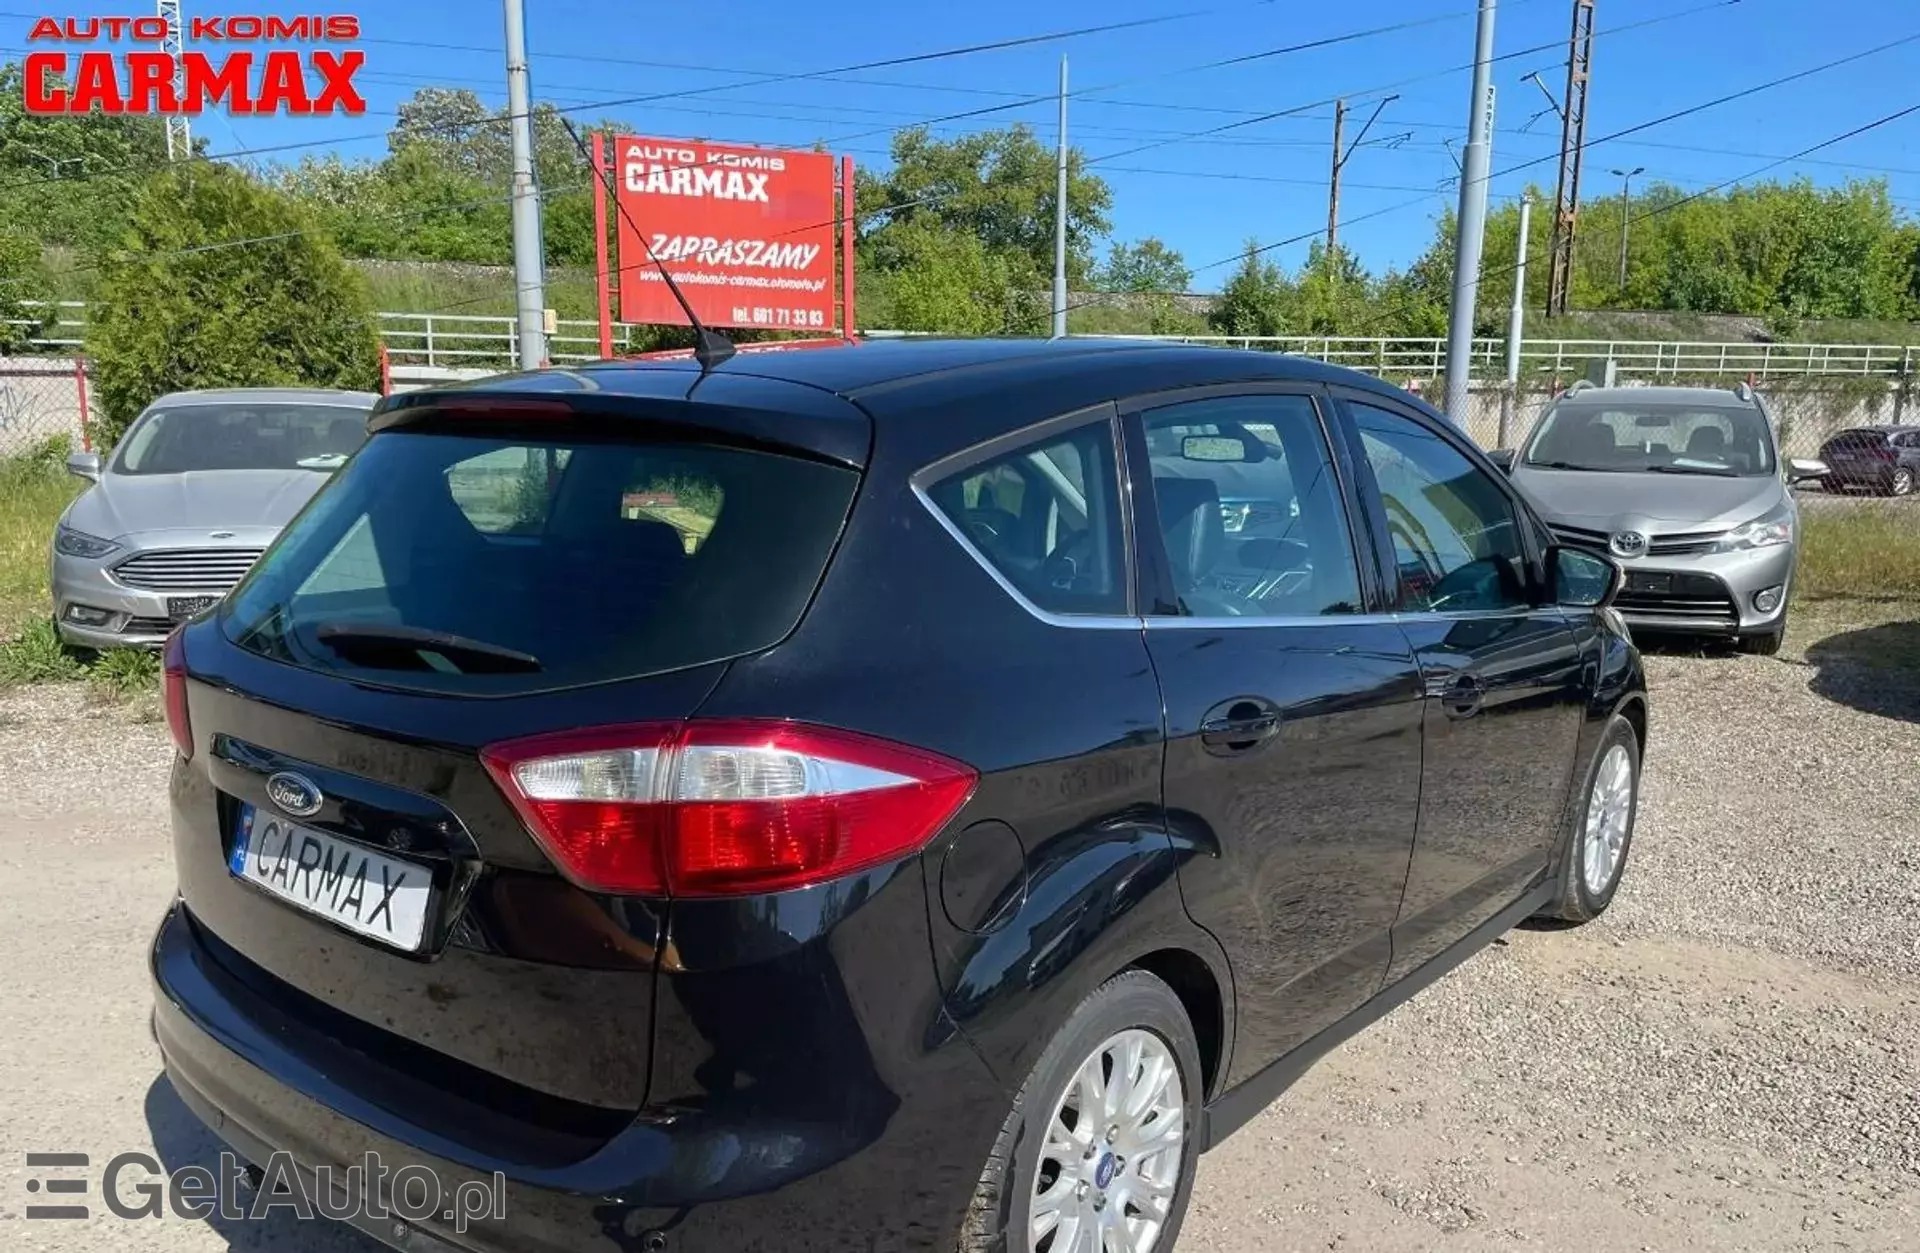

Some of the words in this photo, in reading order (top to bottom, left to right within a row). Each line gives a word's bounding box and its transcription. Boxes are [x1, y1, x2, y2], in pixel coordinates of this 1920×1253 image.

[626, 145, 696, 163] AUTO
[706, 151, 786, 171] KOMIS
[625, 162, 769, 203] CARMAX
[646, 233, 821, 271] ZAPRASZAMY
[640, 269, 827, 293] wwwautokomis-carmax.otomoto.pl
[732, 306, 751, 323] tel.
[776, 308, 790, 325] 71
[792, 308, 807, 326] 33
[273, 783, 305, 808] Ford
[256, 820, 407, 934] CARMAX
